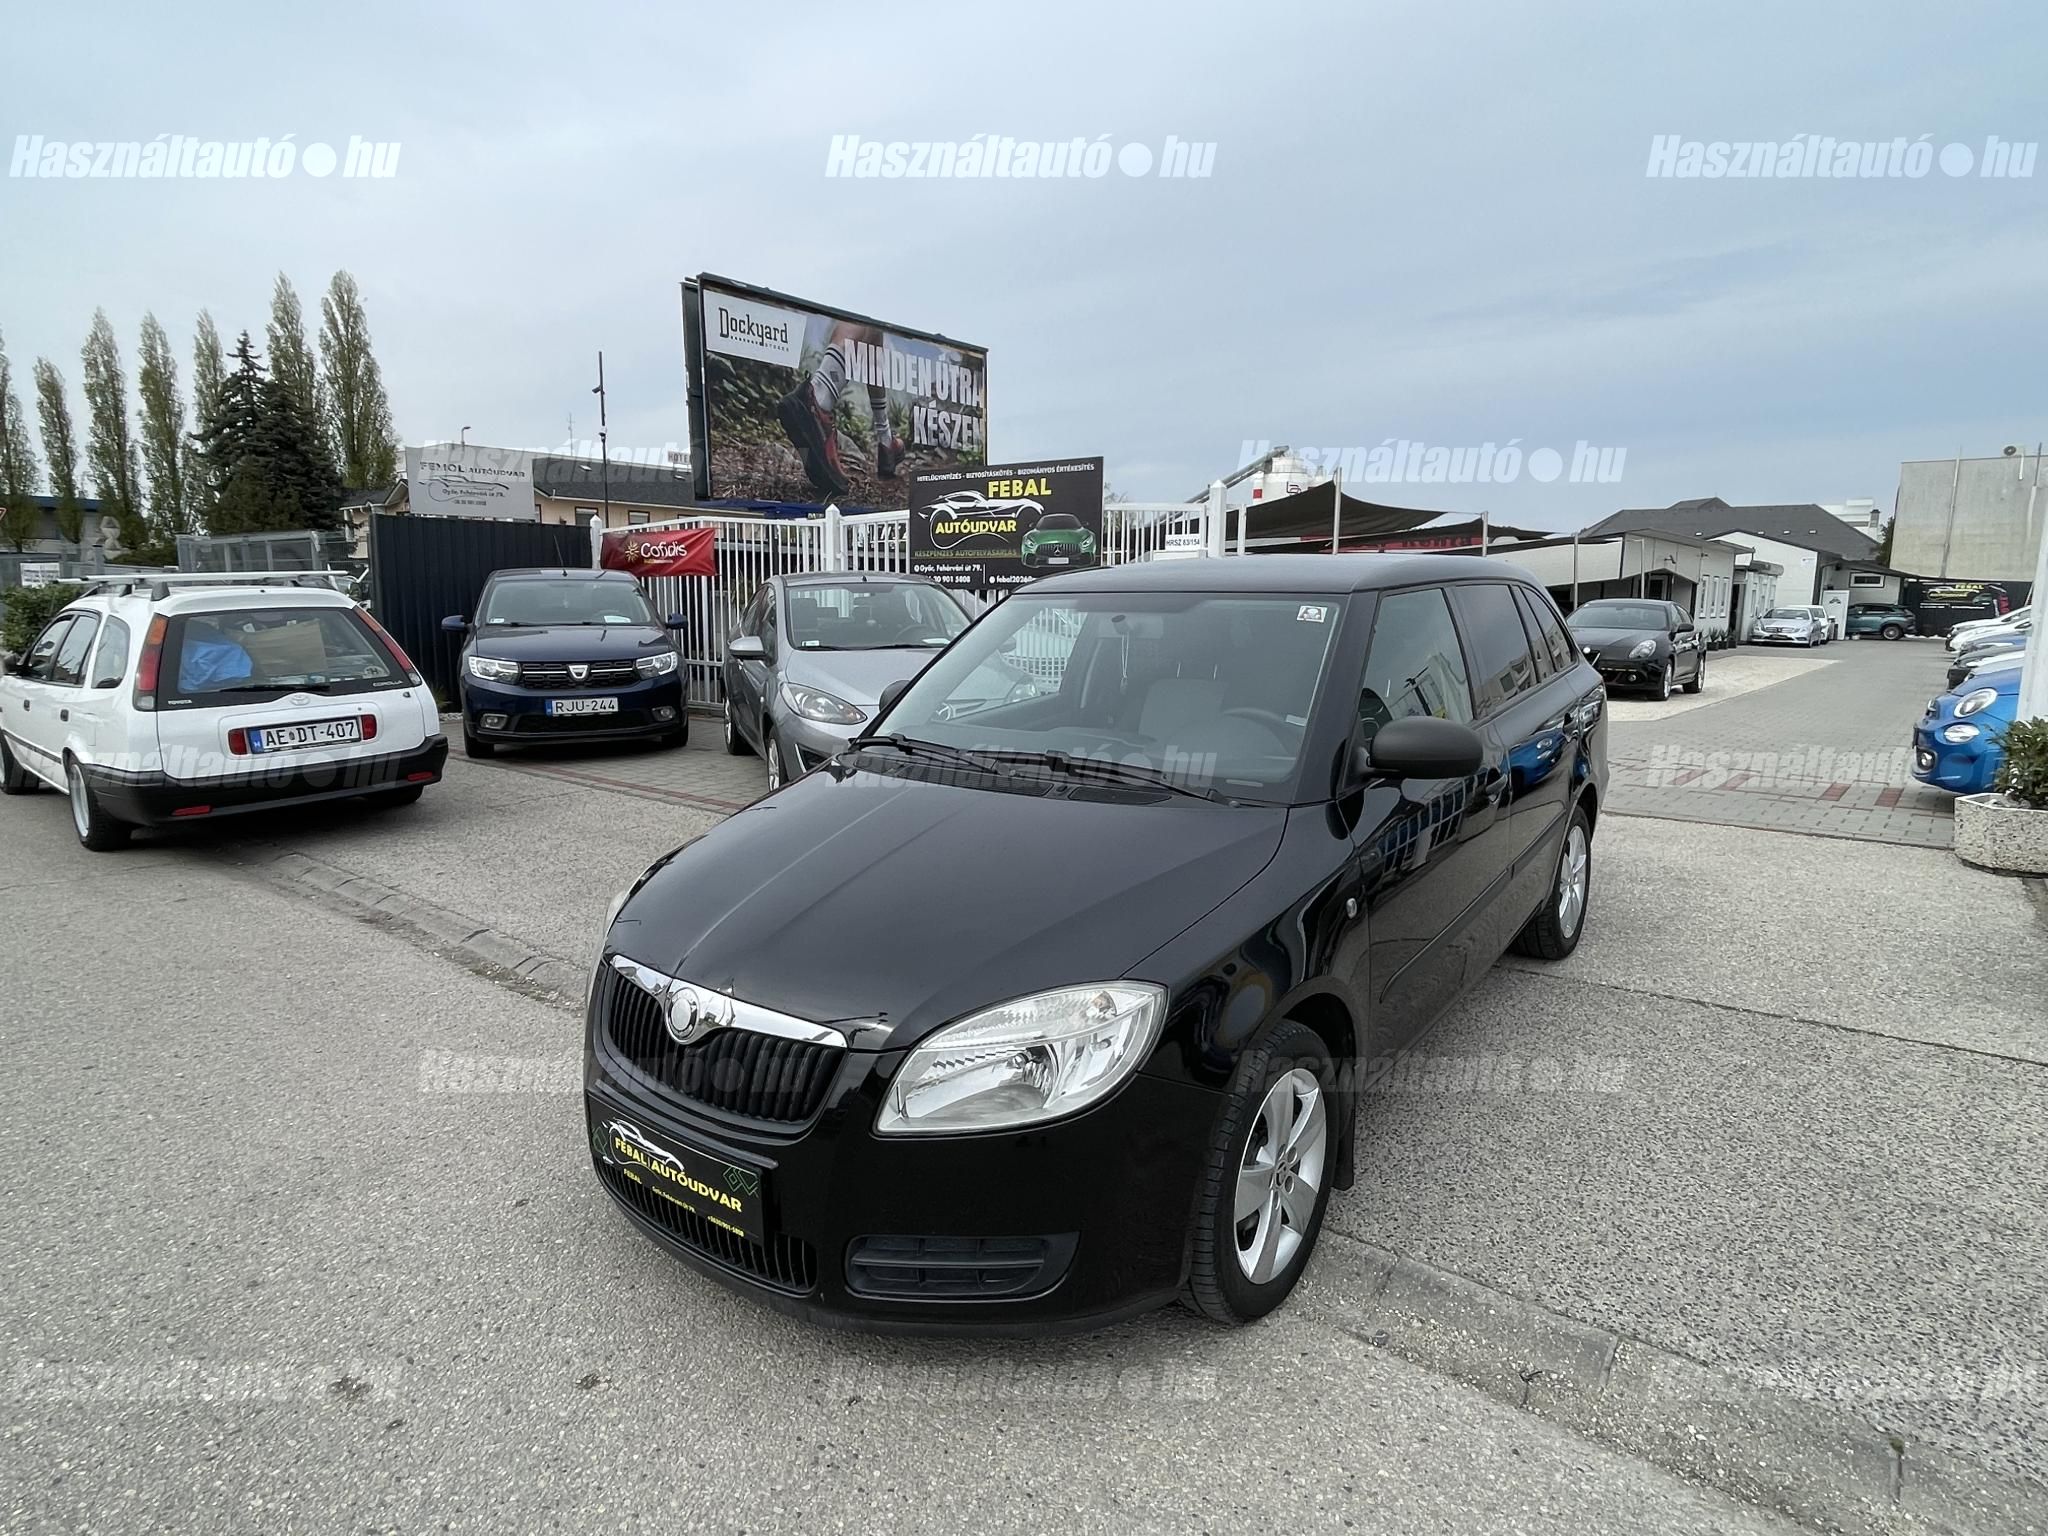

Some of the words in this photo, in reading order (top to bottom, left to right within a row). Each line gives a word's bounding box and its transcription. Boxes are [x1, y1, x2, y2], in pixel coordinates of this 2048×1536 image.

[718, 306, 788, 347] Dockyard
[844, 338, 932, 398] MINDEN
[419, 461, 465, 473] FEMOL
[987, 477, 1052, 498] FEBAL
[935, 518, 1017, 534] AUTÓUDVAR
[640, 541, 688, 558] Cofidis
[555, 699, 615, 713] RJU-244
[614, 1137, 647, 1166] FEBAL
[651, 1160, 742, 1213] AUTÓUDVAR
